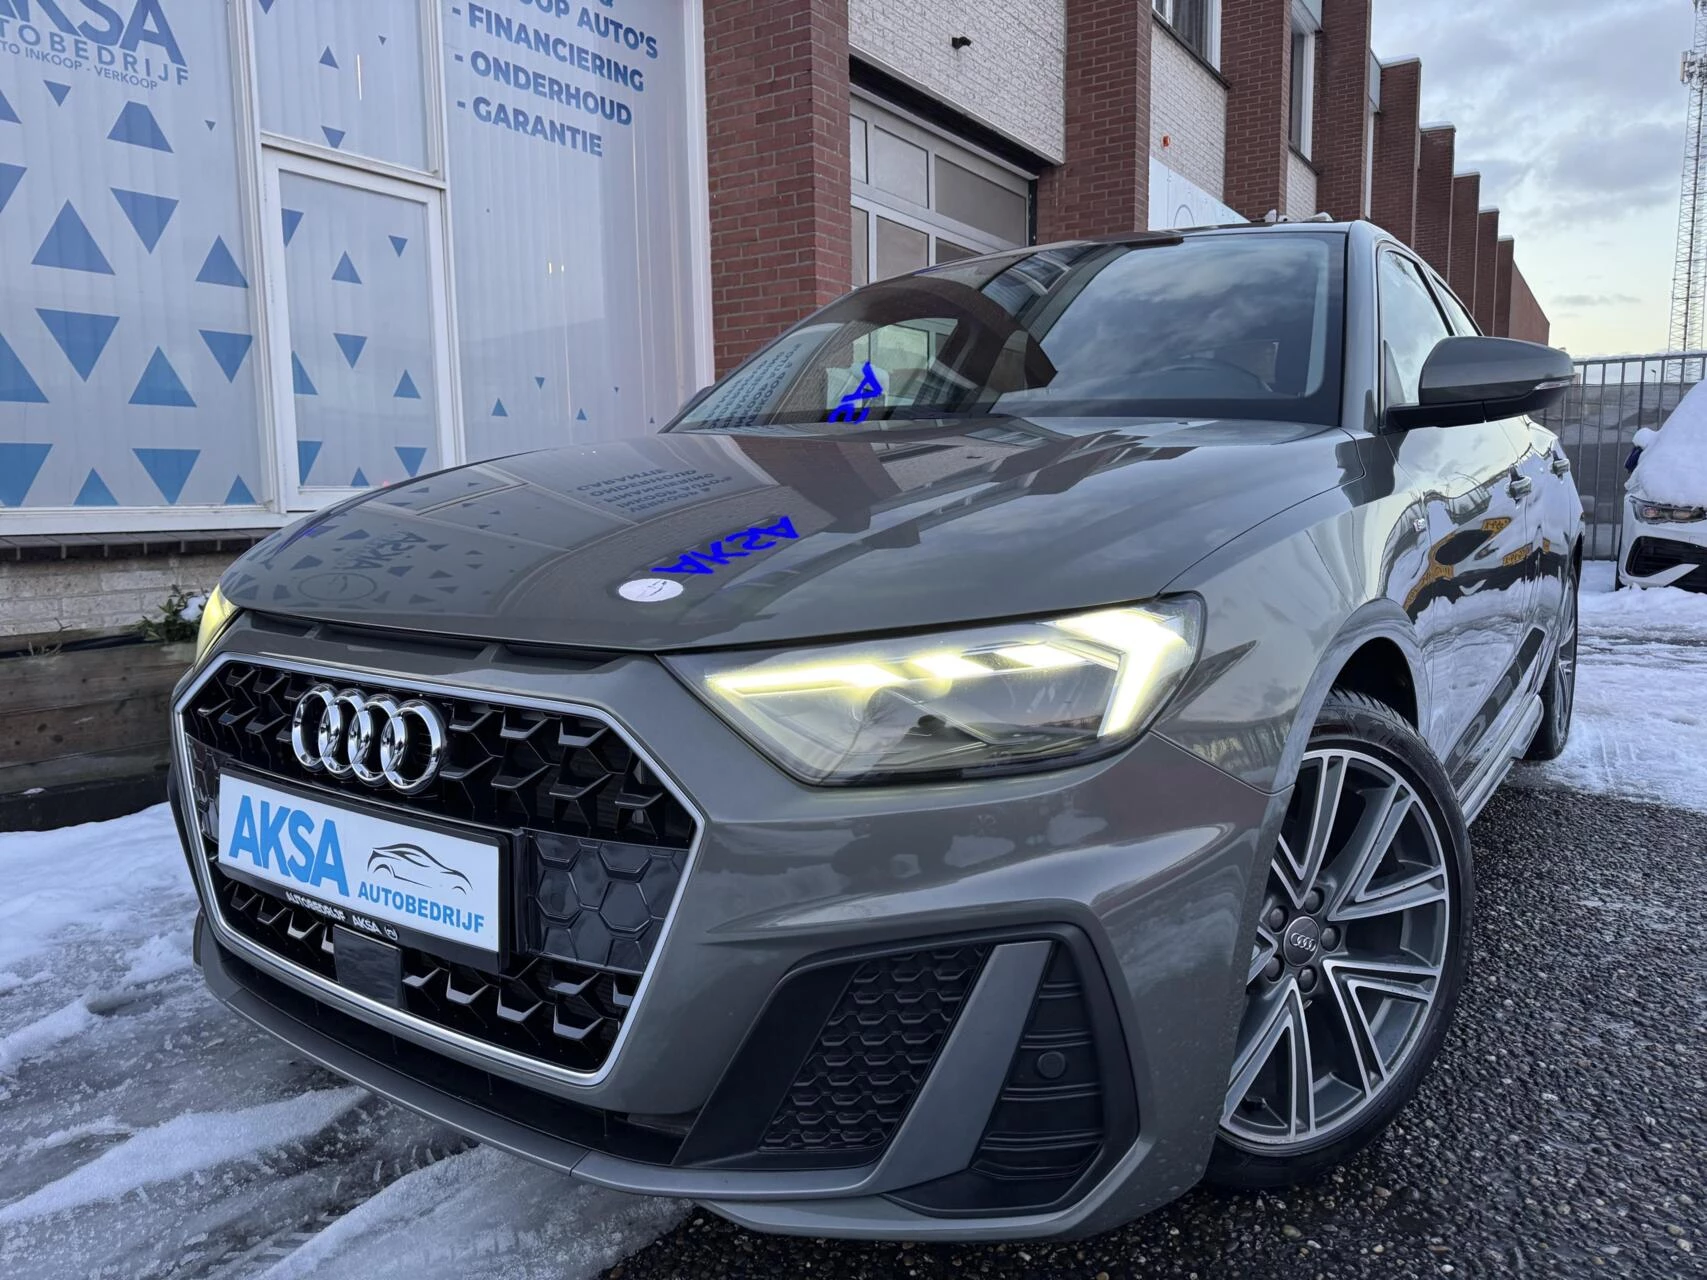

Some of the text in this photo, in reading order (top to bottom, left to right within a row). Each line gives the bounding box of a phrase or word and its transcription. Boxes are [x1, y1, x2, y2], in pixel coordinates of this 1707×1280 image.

[468, 2, 645, 92] FINANCIERING
[577, 7, 659, 59] AUTO'S
[25, 47, 82, 71] INKOOP
[94, 65, 158, 91] VERKOOP
[470, 50, 633, 126] ONDERHOUD
[472, 96, 603, 157] GARANTIE
[228, 795, 350, 897] AKSA
[352, 915, 382, 935] AKSA
[357, 881, 485, 933] AUTOBEDRIJF
